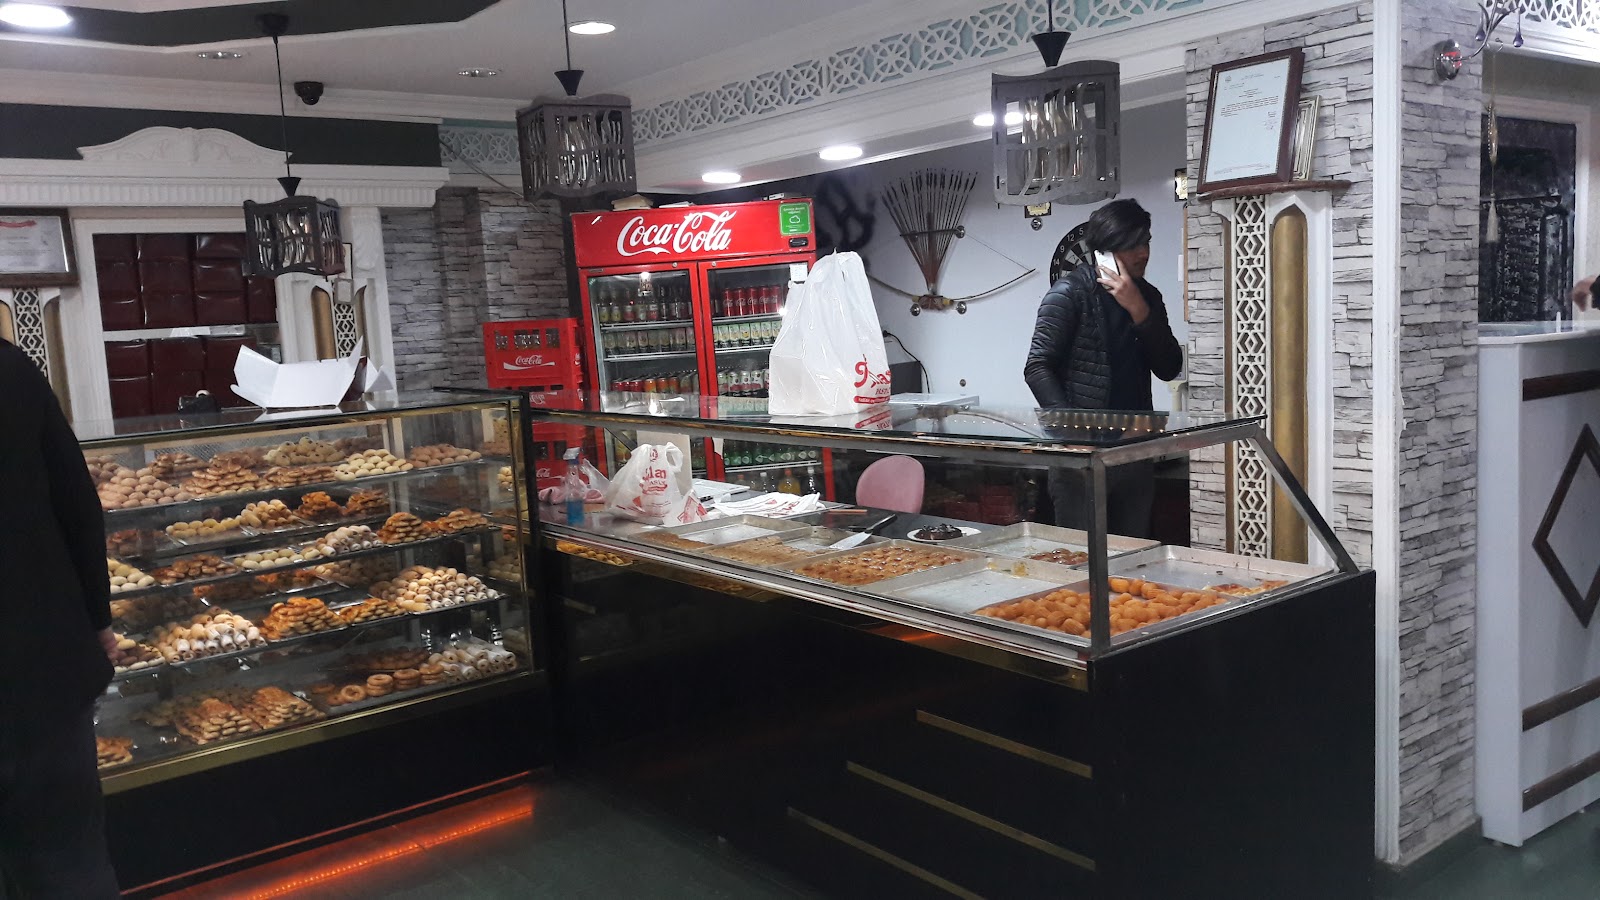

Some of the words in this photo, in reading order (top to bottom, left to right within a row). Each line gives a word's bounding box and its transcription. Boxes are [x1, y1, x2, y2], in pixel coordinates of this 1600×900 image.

[617, 210, 737, 257] Coca-Cola
[1078, 227, 1084, 236] 5
[1066, 233, 1075, 242] 12
[1060, 245, 1065, 253] 9
[1053, 258, 1060, 266] 14
[1051, 272, 1060, 281] 11
[515, 354, 543, 366] Coca-Cola
